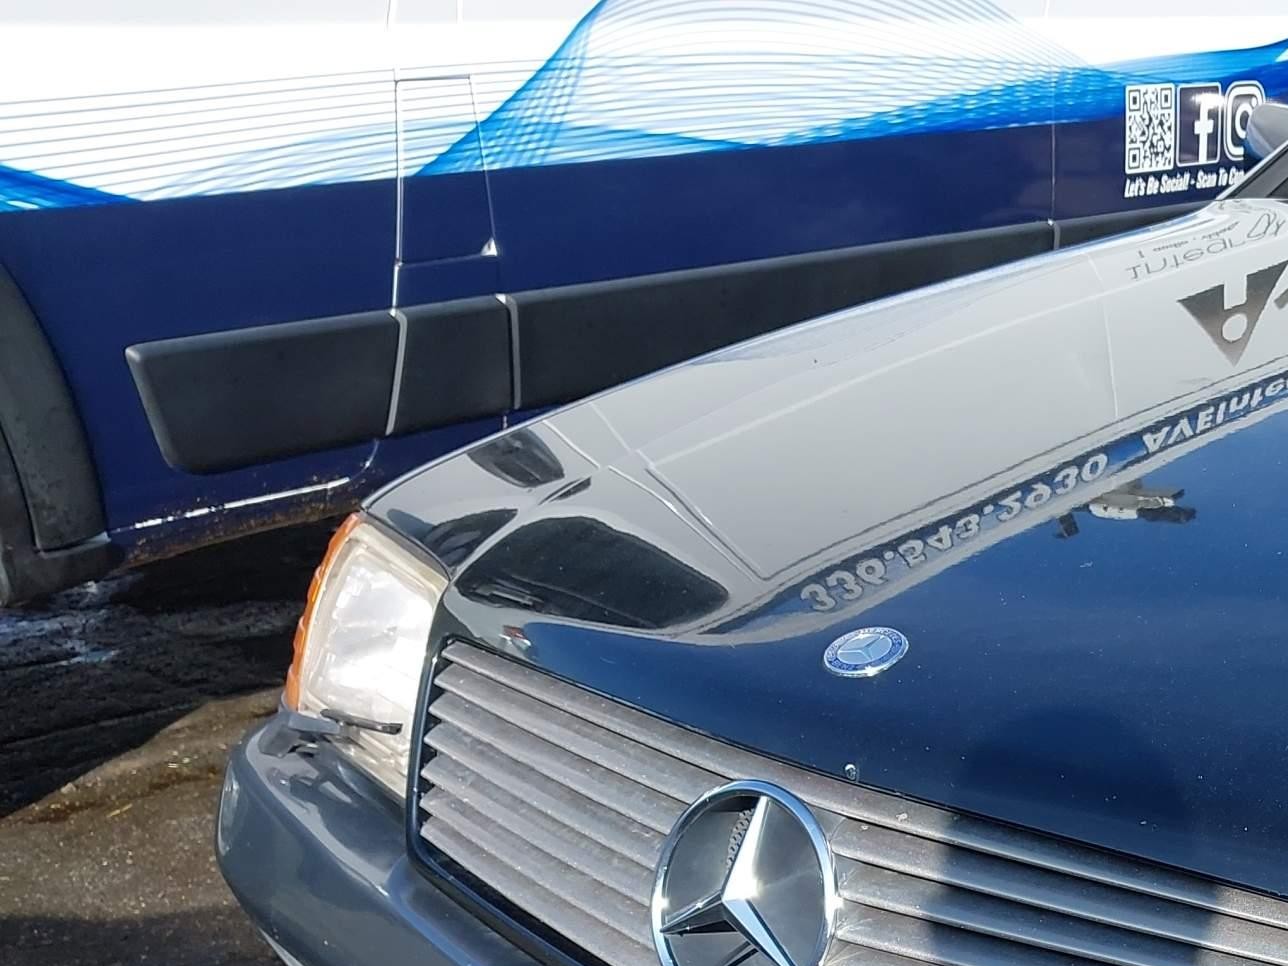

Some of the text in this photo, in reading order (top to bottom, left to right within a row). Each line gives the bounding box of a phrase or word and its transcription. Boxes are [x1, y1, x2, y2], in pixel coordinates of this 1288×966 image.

[1124, 178, 1145, 198] Let's
[1146, 175, 1159, 195] Be
[1196, 169, 1217, 189] Scan
[1218, 167, 1228, 186] To
